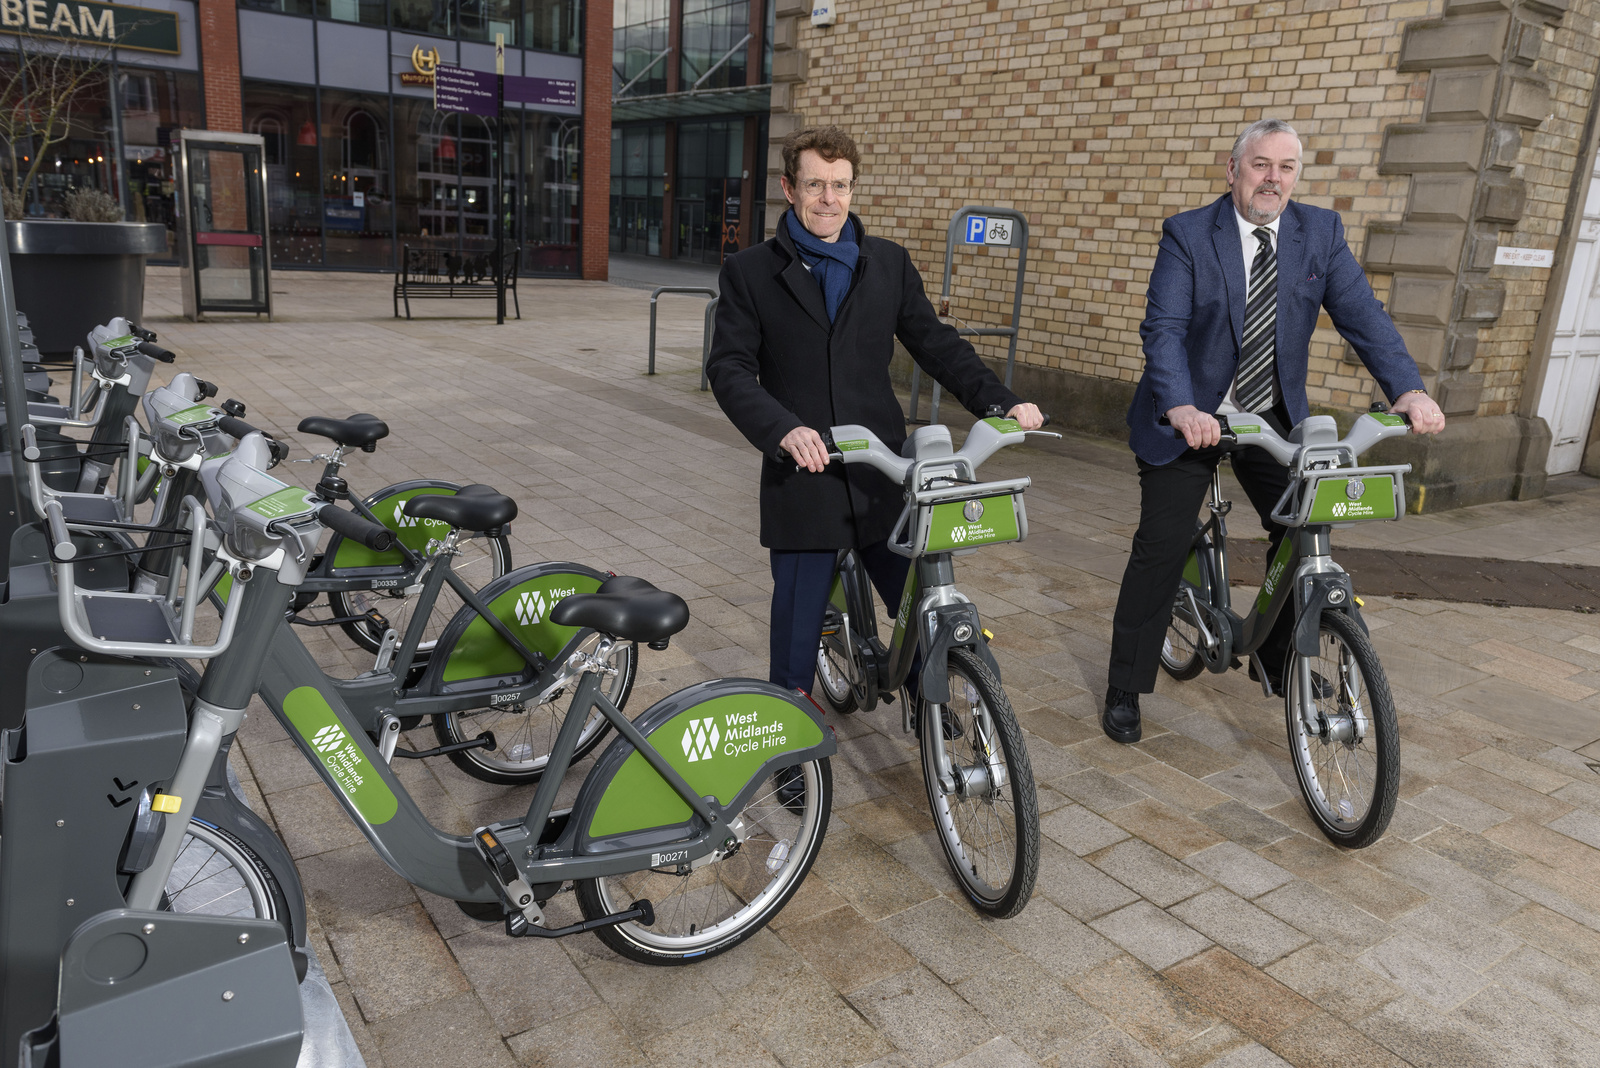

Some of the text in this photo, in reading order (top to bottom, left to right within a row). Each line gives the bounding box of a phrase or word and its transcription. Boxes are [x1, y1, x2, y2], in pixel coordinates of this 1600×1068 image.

[0, 0, 116, 40] BEAM
[402, 73, 429, 83] Hungry
[457, 87, 472, 95] Campus
[970, 219, 984, 242] P
[968, 528, 994, 536] Midlands
[549, 587, 576, 599] West
[497, 692, 521, 702] 00257
[725, 711, 758, 727] West
[724, 720, 784, 742] Midlands
[344, 742, 362, 765] West
[724, 735, 787, 758] Cycle Hire
[327, 755, 357, 794] Cycle Hire
[335, 750, 363, 786] Midlands
[218, 828, 272, 879] MARATHON PLUS
[660, 850, 688, 863] 00271
